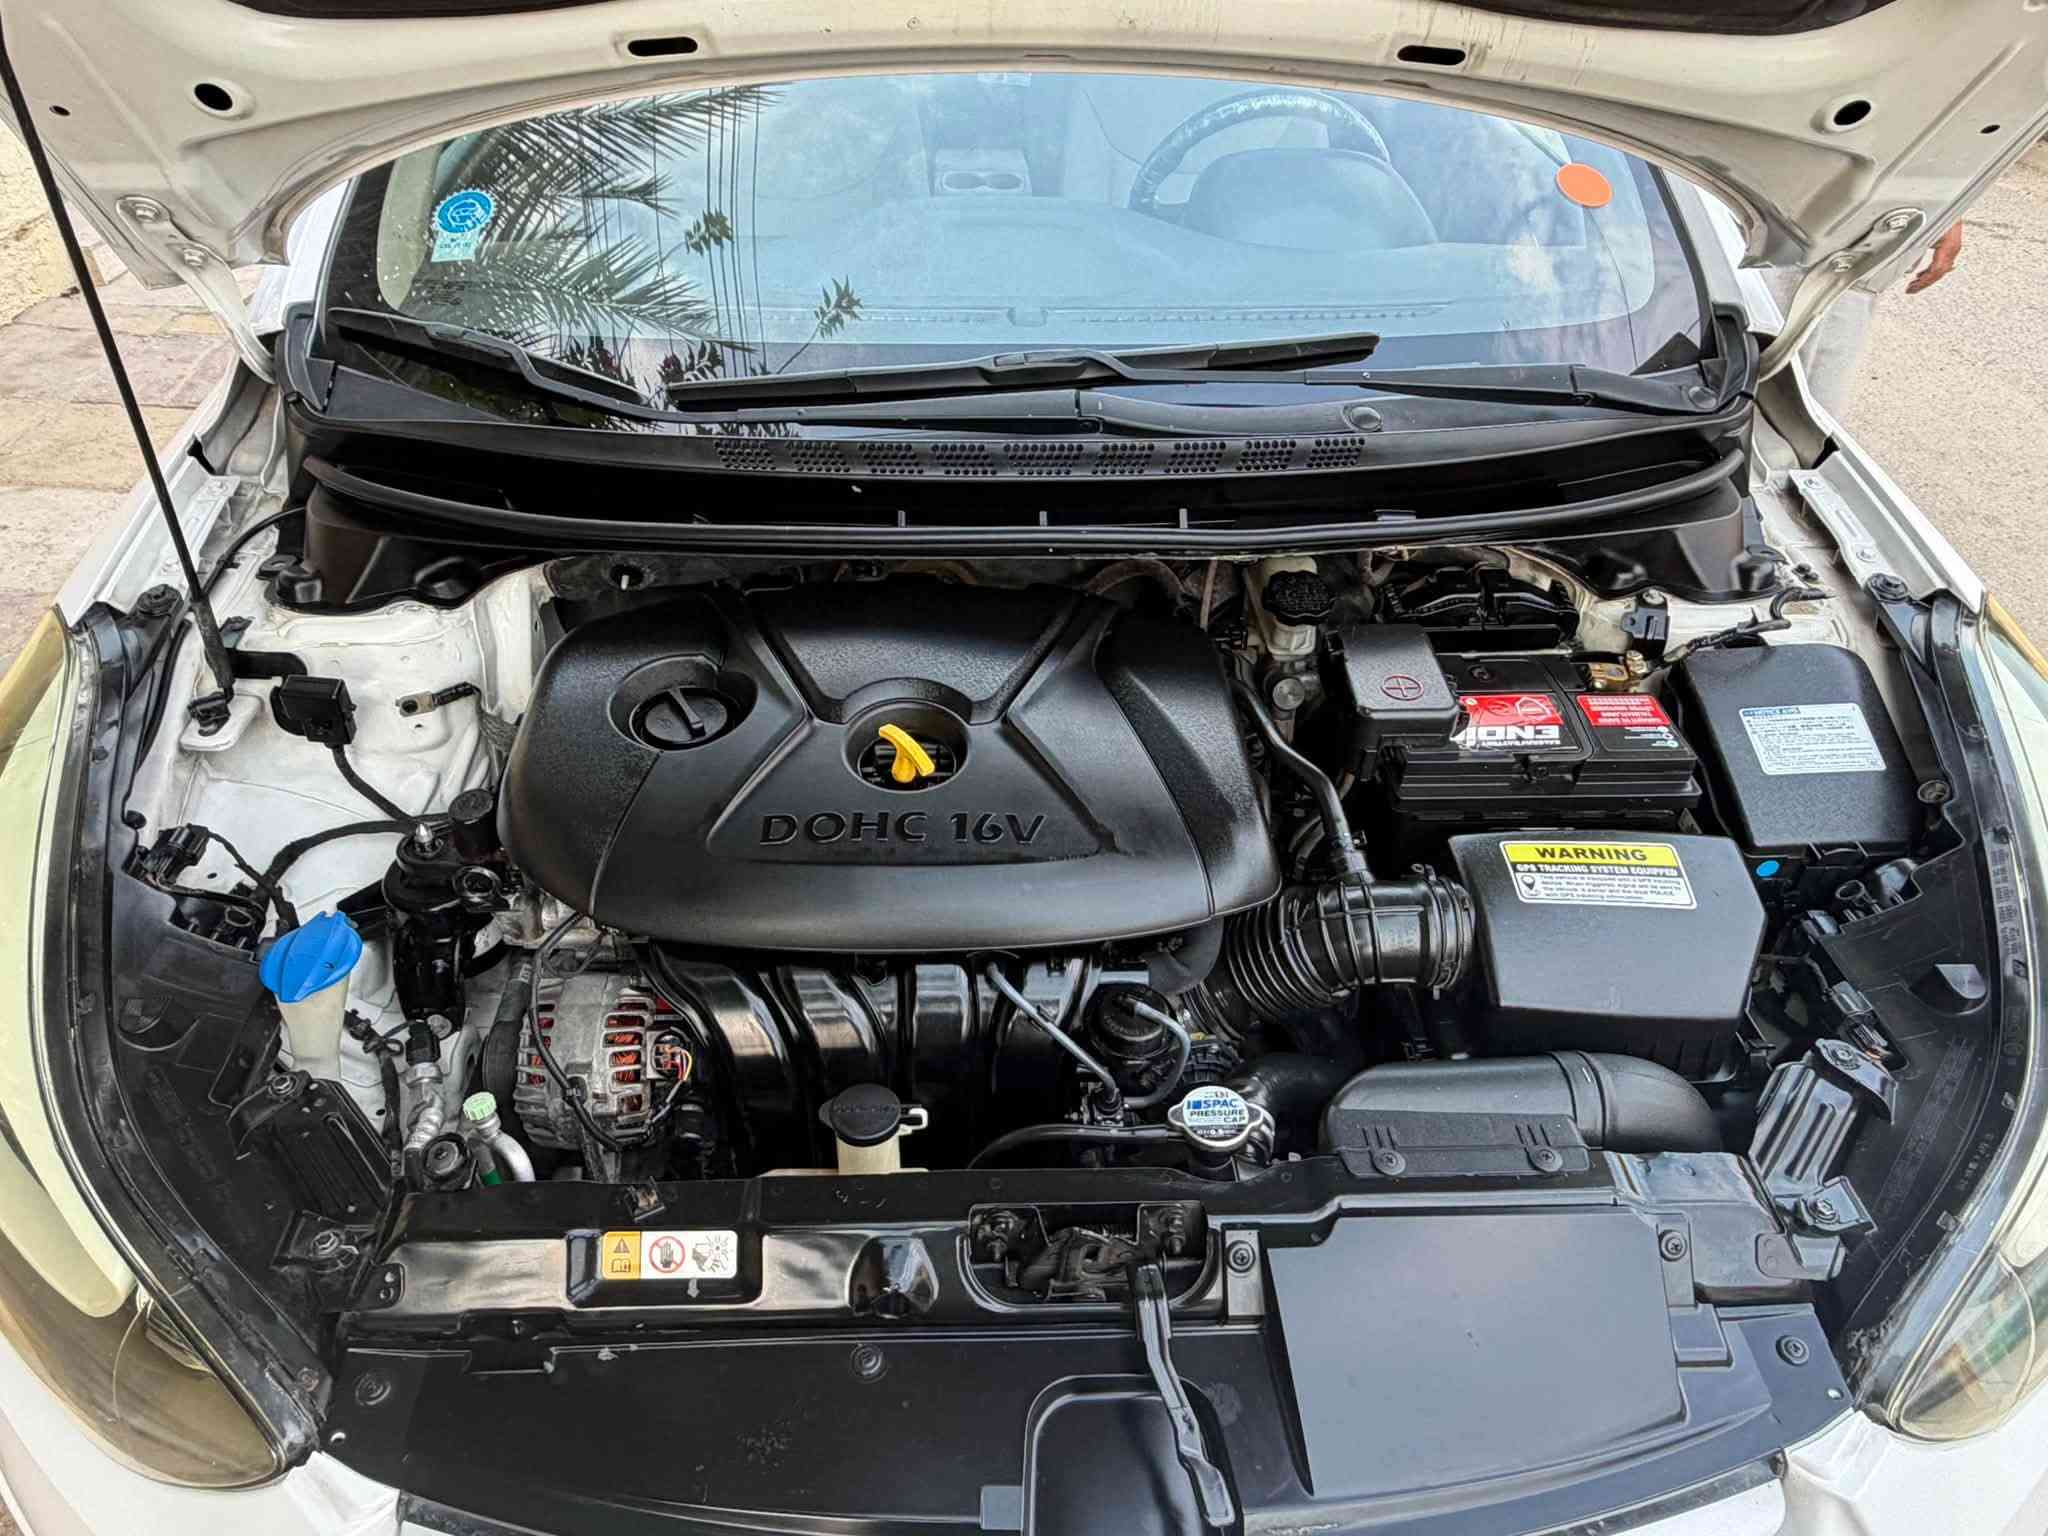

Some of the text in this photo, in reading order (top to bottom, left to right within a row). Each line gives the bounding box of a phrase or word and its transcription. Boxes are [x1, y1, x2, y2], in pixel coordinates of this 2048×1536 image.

[759, 810, 1047, 845] DOHC 16V
[1535, 846, 1648, 861] WARNING
[1516, 863, 1537, 873] GPS
[1539, 864, 1589, 874] TRACKING
[1591, 865, 1629, 876] SYSTEM
[1203, 1099, 1238, 1109] SPAC
[1190, 1109, 1244, 1118] PRESSURE
